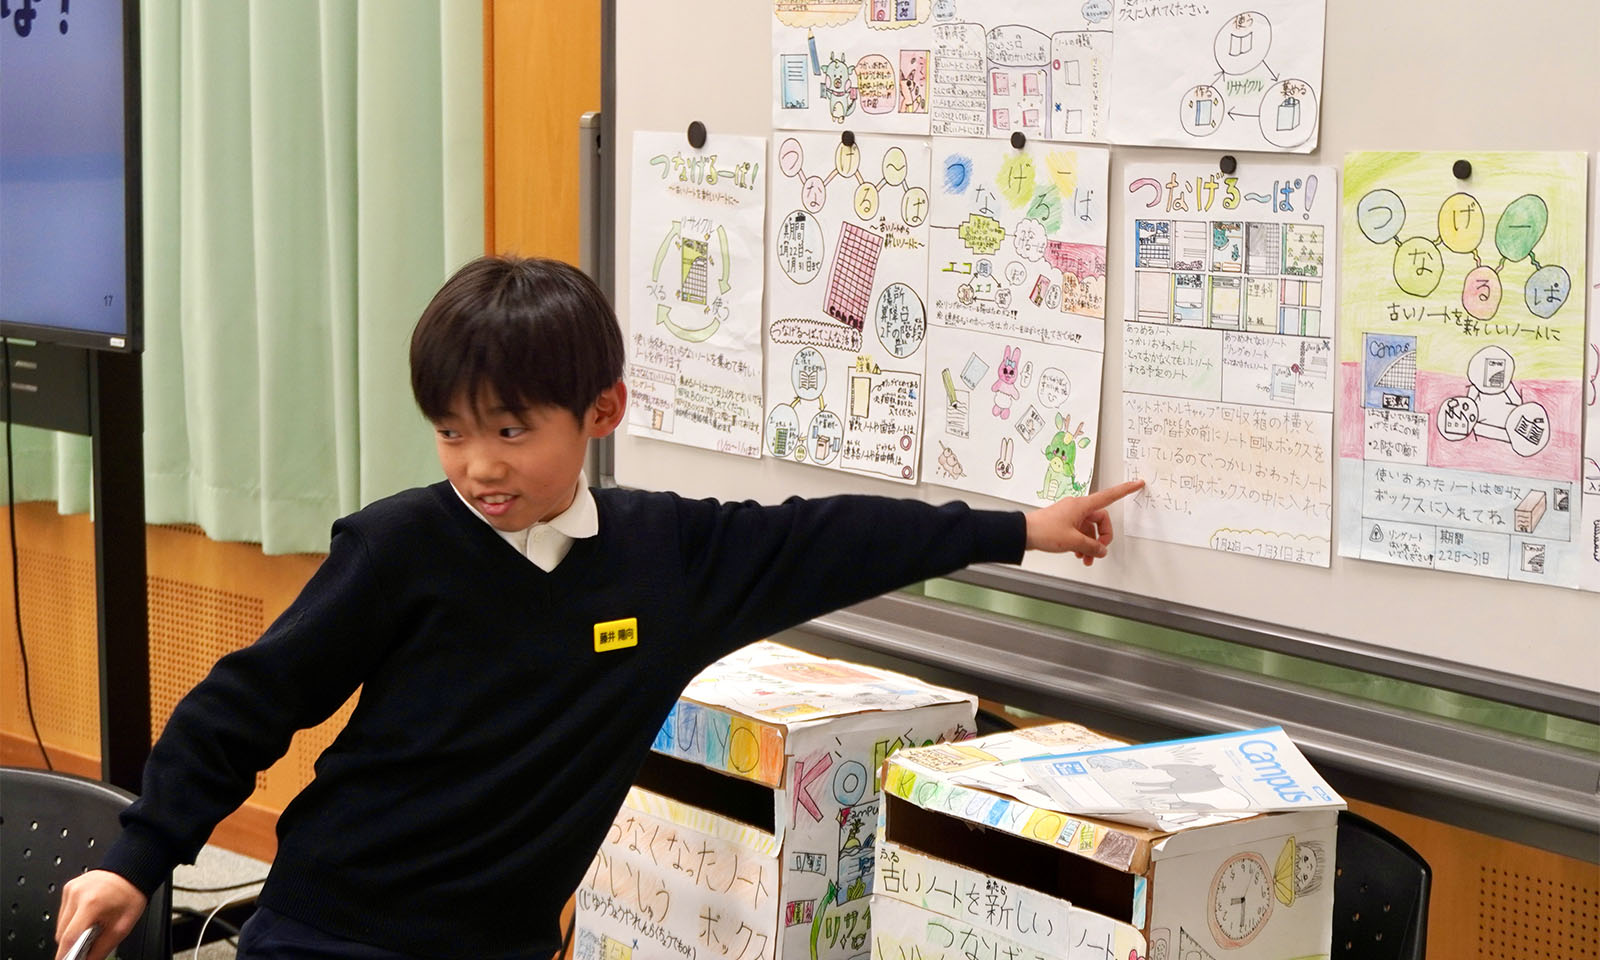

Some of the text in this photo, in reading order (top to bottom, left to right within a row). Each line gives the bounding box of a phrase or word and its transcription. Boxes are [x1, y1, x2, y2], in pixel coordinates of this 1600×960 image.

[1226, 80, 1264, 97] リサイクル
[103, 295, 113, 306] 17
[1126, 400, 1315, 434] ペットボトルキャップ回収箱の横と
[1128, 415, 1326, 464] 2階の階段の前にノート回収ボックスを
[1126, 437, 1327, 491] 置いているので、つかいおわったノート
[1238, 740, 1313, 803] Campus
